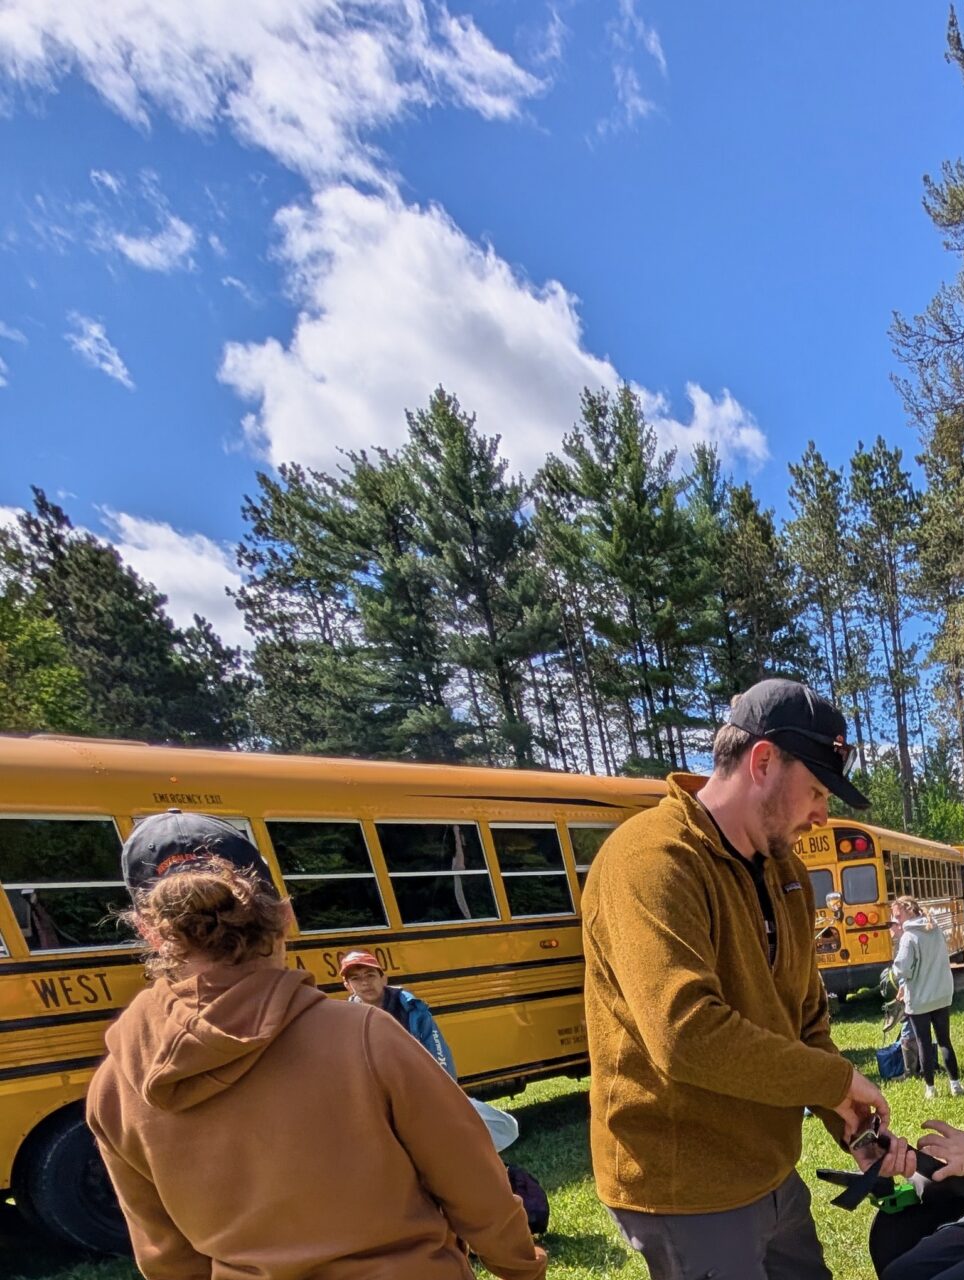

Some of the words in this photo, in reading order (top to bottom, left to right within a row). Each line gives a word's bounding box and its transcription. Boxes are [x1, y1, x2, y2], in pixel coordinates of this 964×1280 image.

[152, 793, 202, 804] EMERGENCY
[203, 794, 223, 805] EXIT
[809, 835, 830, 853] BUS
[861, 943, 869, 954] 12
[322, 948, 400, 978] SCOL
[32, 973, 113, 1009] WEST
